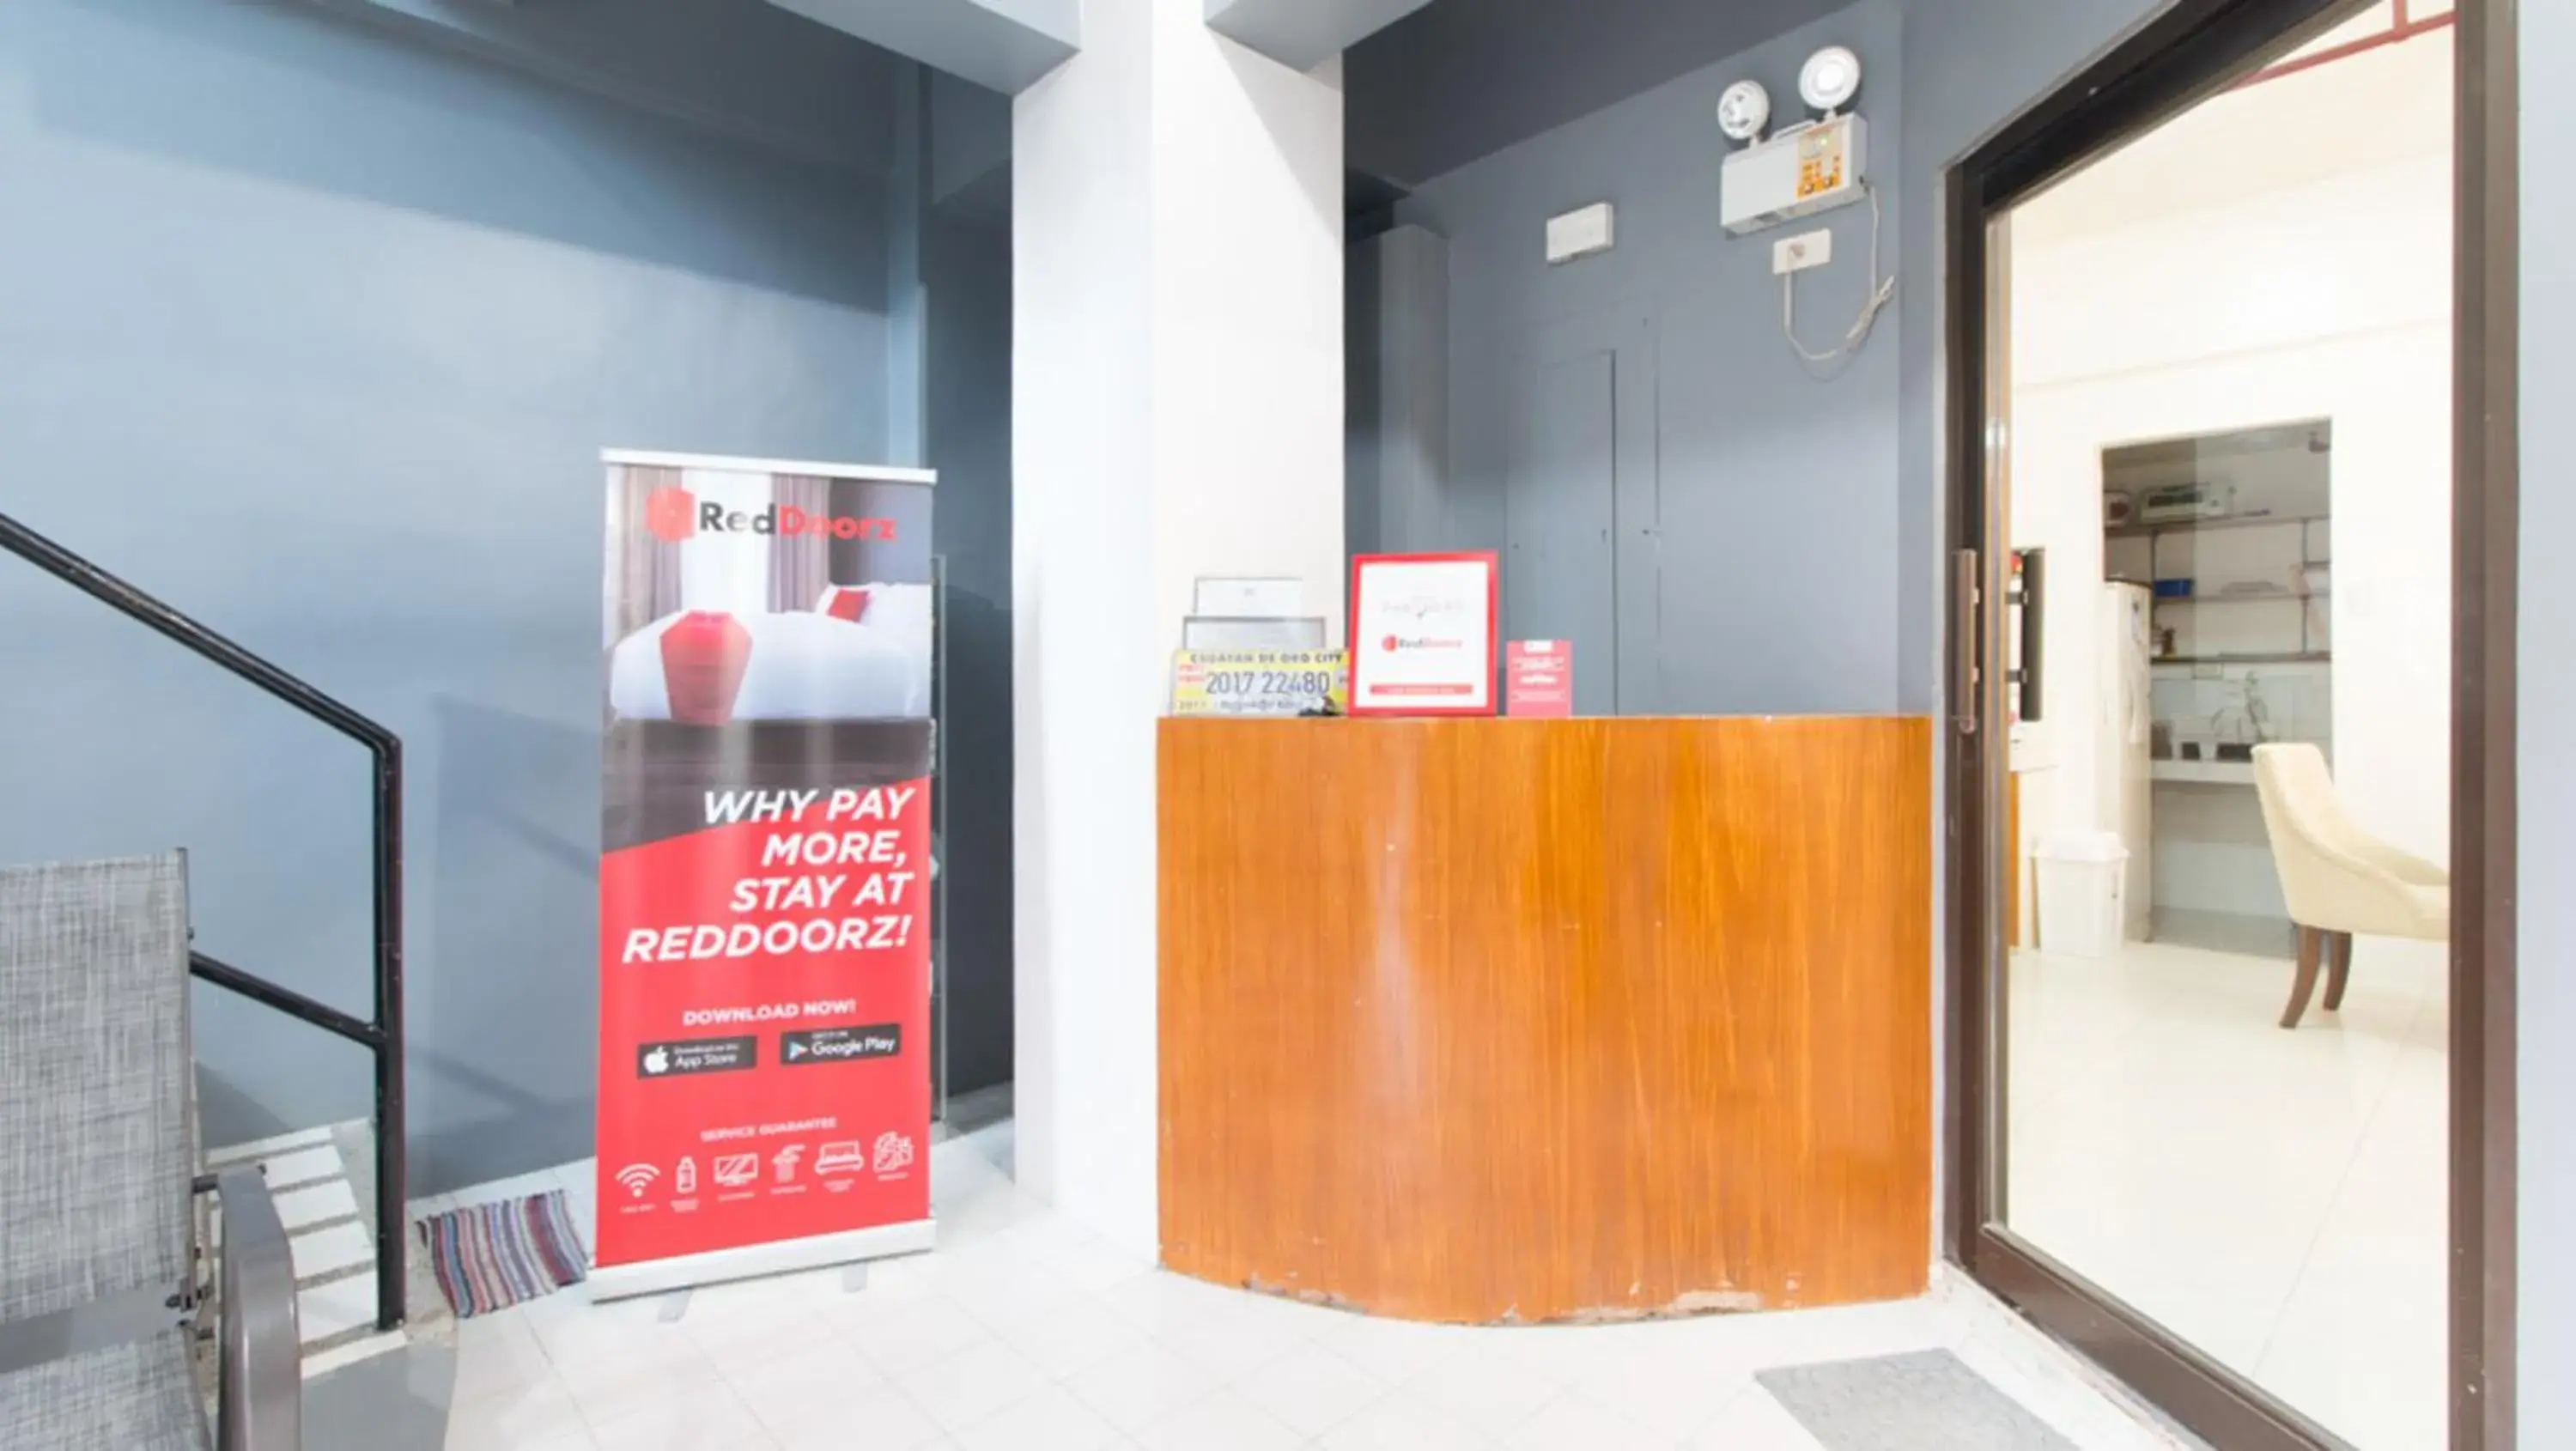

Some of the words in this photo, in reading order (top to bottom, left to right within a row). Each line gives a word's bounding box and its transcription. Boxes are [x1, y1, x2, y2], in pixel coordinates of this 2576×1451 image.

[699, 501, 896, 540] RedDoorz
[1315, 653, 1342, 663] CITY
[1206, 671, 1255, 695] 2017
[704, 789, 818, 823] WHY
[826, 787, 915, 821] PAY
[761, 830, 907, 867] MORE,
[729, 874, 847, 913] STAY
[853, 872, 914, 907] AT
[622, 915, 913, 964] REDDOORZ!
[683, 1004, 799, 1026] DOWNLOAD
[803, 999, 856, 1016] NOW!
[811, 1038, 863, 1057] Google
[865, 1033, 896, 1052] Play
[675, 1055, 702, 1070] App
[705, 1052, 738, 1065] Store
